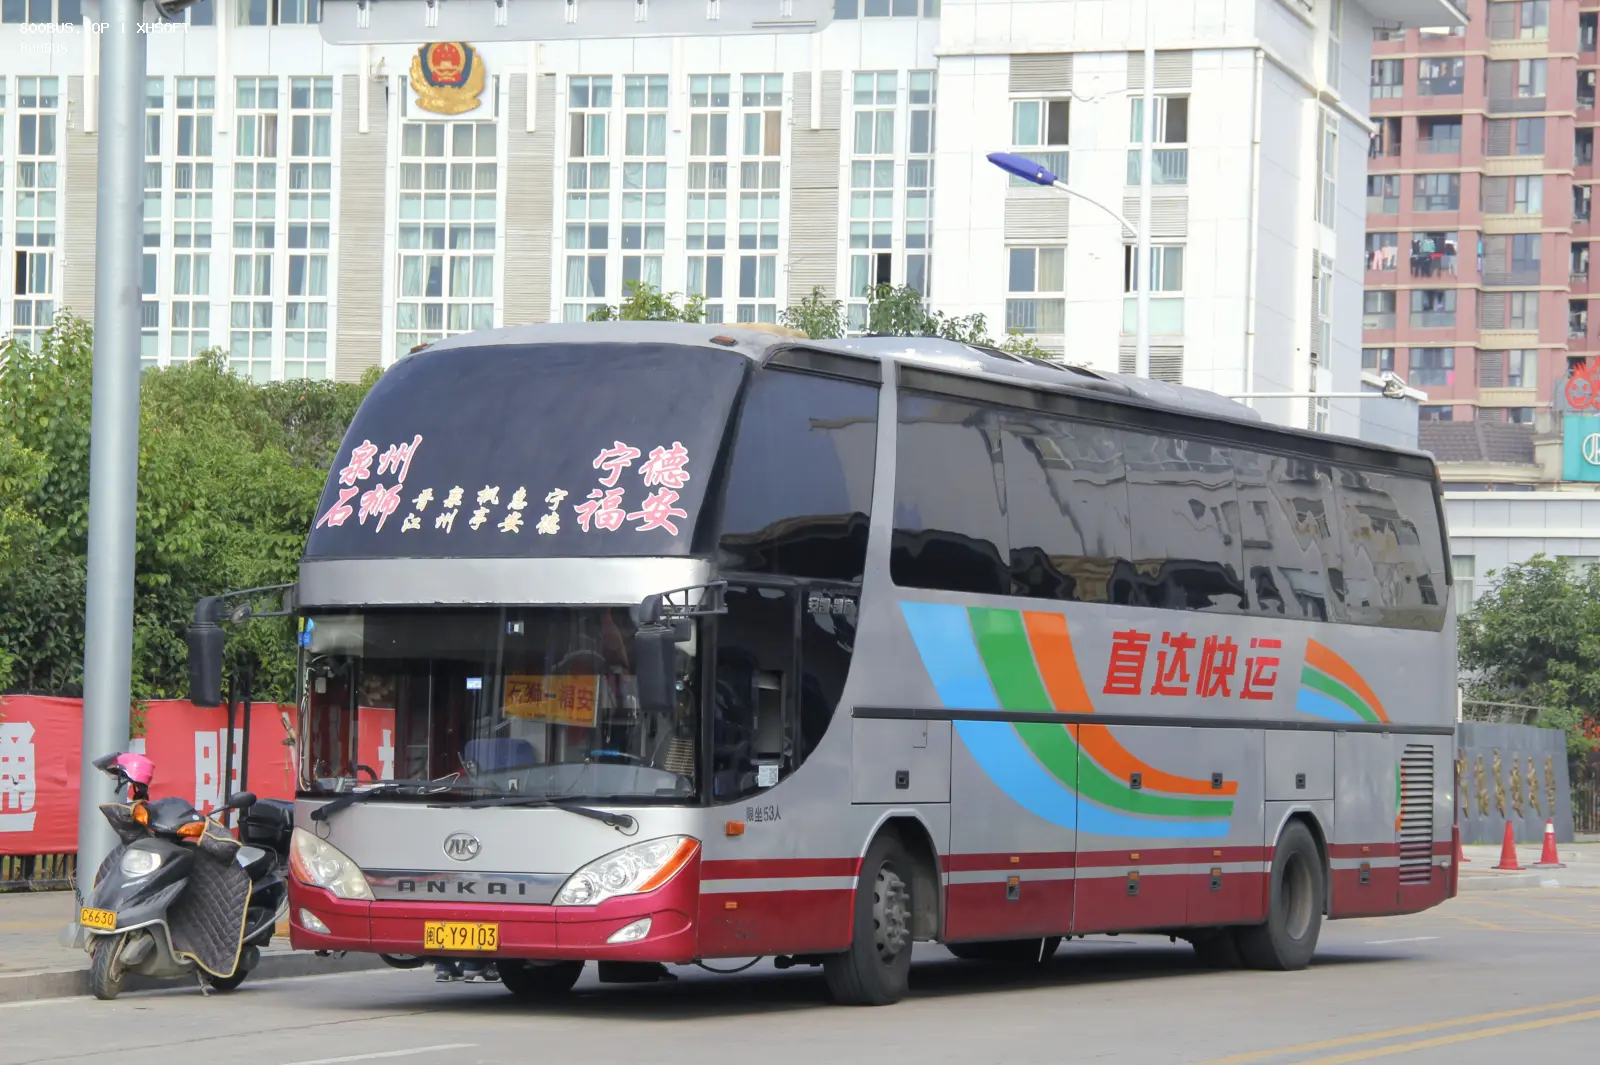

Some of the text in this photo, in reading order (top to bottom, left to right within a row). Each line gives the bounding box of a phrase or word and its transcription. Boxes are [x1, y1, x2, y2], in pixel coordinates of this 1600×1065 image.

[339, 434, 423, 486] 泉州
[593, 440, 690, 489] 宁德
[573, 486, 688, 535] 福安
[1103, 629, 1282, 700] 直达快运
[397, 879, 527, 895] ANKAI
[81, 909, 114, 926] C6630
